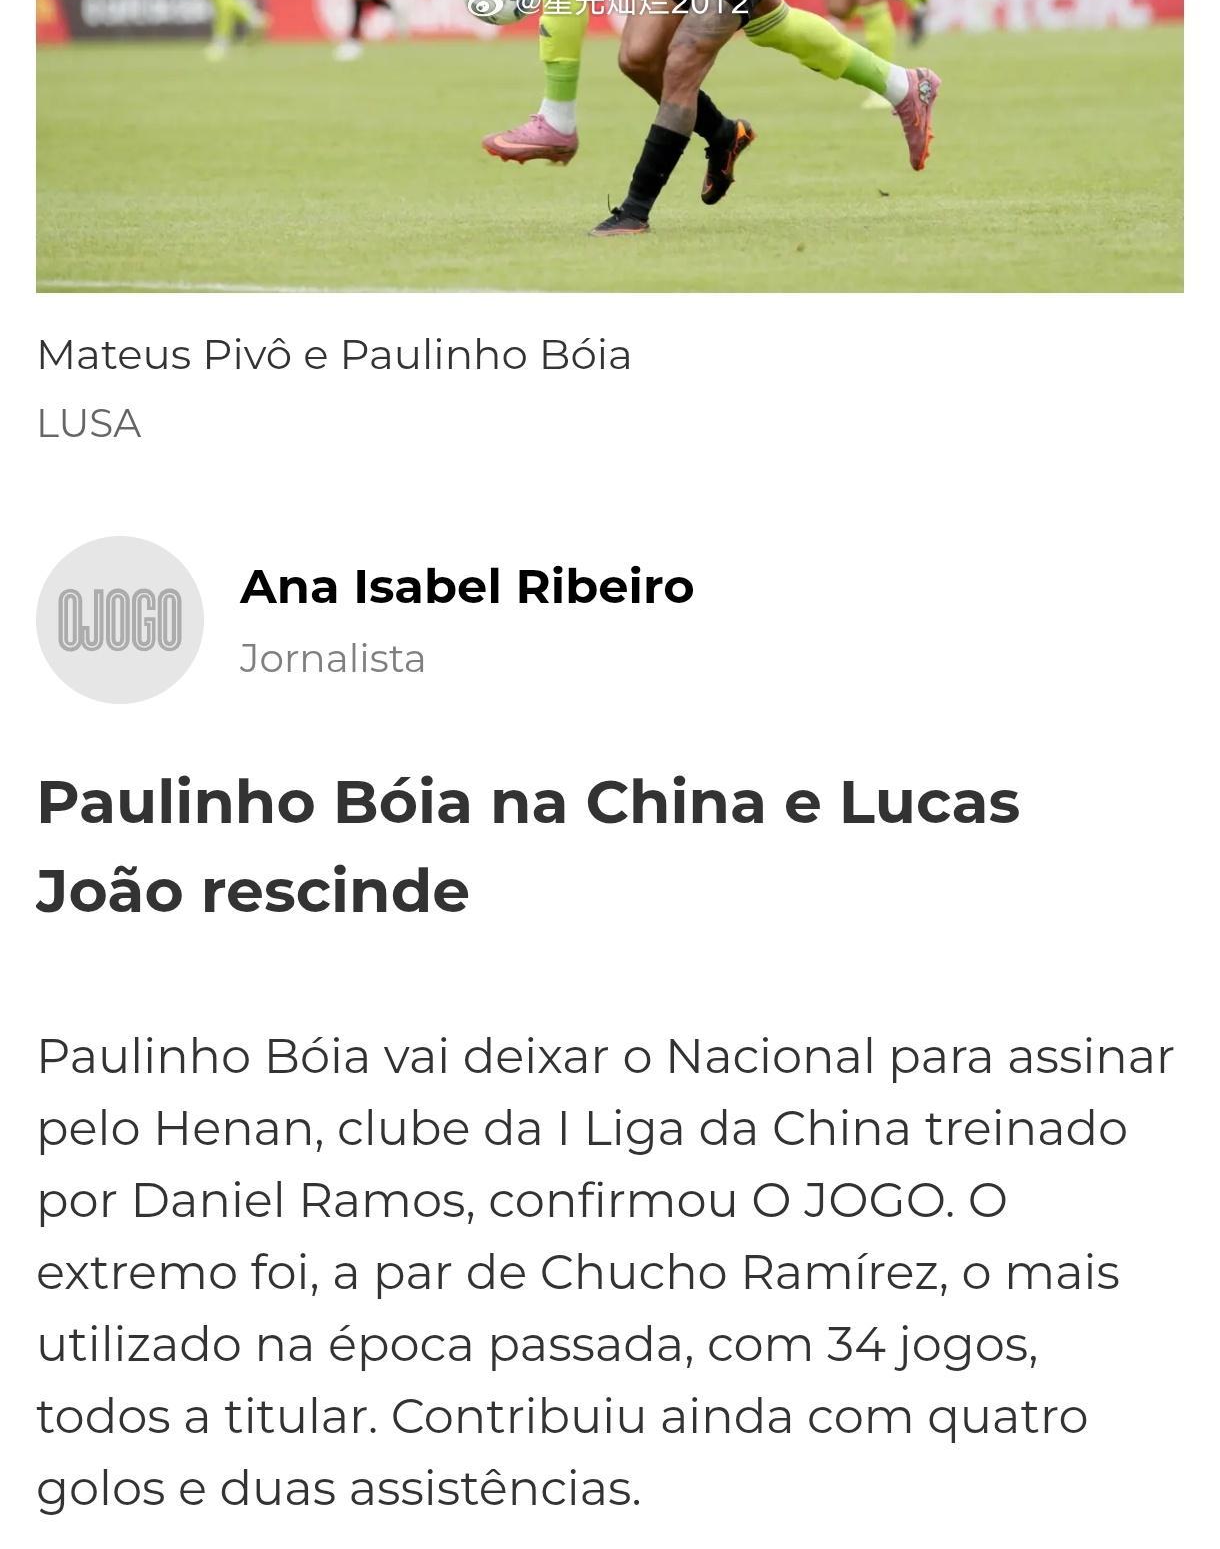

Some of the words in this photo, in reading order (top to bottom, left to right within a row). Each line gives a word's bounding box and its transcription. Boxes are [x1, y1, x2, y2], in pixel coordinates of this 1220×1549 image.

[40, 340, 190, 369] Mateus
[207, 338, 290, 369] Pivô
[305, 347, 327, 369] e
[344, 338, 526, 369] Paulinho
[543, 338, 629, 369] Bóia
[40, 409, 141, 437] LUSA
[240, 570, 337, 603] Ana
[357, 567, 499, 603] Isabel
[519, 566, 693, 603] Ribeiro
[240, 643, 423, 672] Jornalista
[41, 775, 314, 823] Paulinho
[337, 775, 469, 823] Bóia
[494, 790, 565, 823] na
[588, 775, 763, 824] China
[786, 790, 820, 823] e
[843, 781, 1019, 823] Lucas
[36, 865, 182, 913] João
[205, 864, 468, 912] rescinde
[41, 1037, 249, 1073] Paulinho
[269, 1037, 367, 1073] Bóia
[384, 1037, 446, 1073] vai
[465, 1037, 608, 1073] deixar
[624, 1047, 651, 1073] o
[670, 1037, 871, 1073] Nacional
[893, 1047, 990, 1083] para
[1010, 1037, 1174, 1074] assinar
[40, 1109, 139, 1155] pelo
[158, 1111, 322, 1152] Henan,
[339, 1109, 469, 1145] clube
[485, 1109, 540, 1145] da
[589, 1109, 682, 1155] Liga
[701, 1109, 755, 1145] da
[774, 1109, 908, 1145] China
[925, 1109, 1126, 1145] treinado
[40, 1191, 117, 1227] por
[136, 1181, 281, 1217] Daniel
[303, 1183, 473, 1224] Ramos,
[490, 1181, 734, 1217] confirmou
[754, 1183, 789, 1217] O
[804, 1183, 953, 1217] JOGO.
[970, 1183, 1006, 1217] O
[38, 1257, 236, 1289] extremo
[251, 1253, 317, 1296] foi,
[335, 1263, 356, 1289] a
[377, 1263, 451, 1299] par
[468, 1253, 525, 1289] de
[542, 1253, 726, 1289] Chucho
[745, 1253, 947, 1296] Ramírez,
[964, 1263, 990, 1289] o
[1009, 1253, 1119, 1289] mais
[40, 1325, 240, 1361] utilizado
[259, 1335, 311, 1361] na
[330, 1325, 471, 1371] época
[492, 1325, 692, 1371] passada,
[709, 1335, 810, 1361] com
[827, 1327, 886, 1361] 34
[894, 1325, 1036, 1371] jogos,
[36, 1397, 169, 1433] todos
[186, 1407, 207, 1433] a
[225, 1397, 376, 1433] titular.
[393, 1397, 643, 1433] Contribuiu
[662, 1397, 790, 1433] ainda
[809, 1407, 910, 1433] com
[929, 1401, 1087, 1443] quatro
[38, 1469, 164, 1515] golos
[180, 1479, 205, 1505] e
[221, 1469, 335, 1505] duas
[351, 1469, 639, 1505] assistências.
